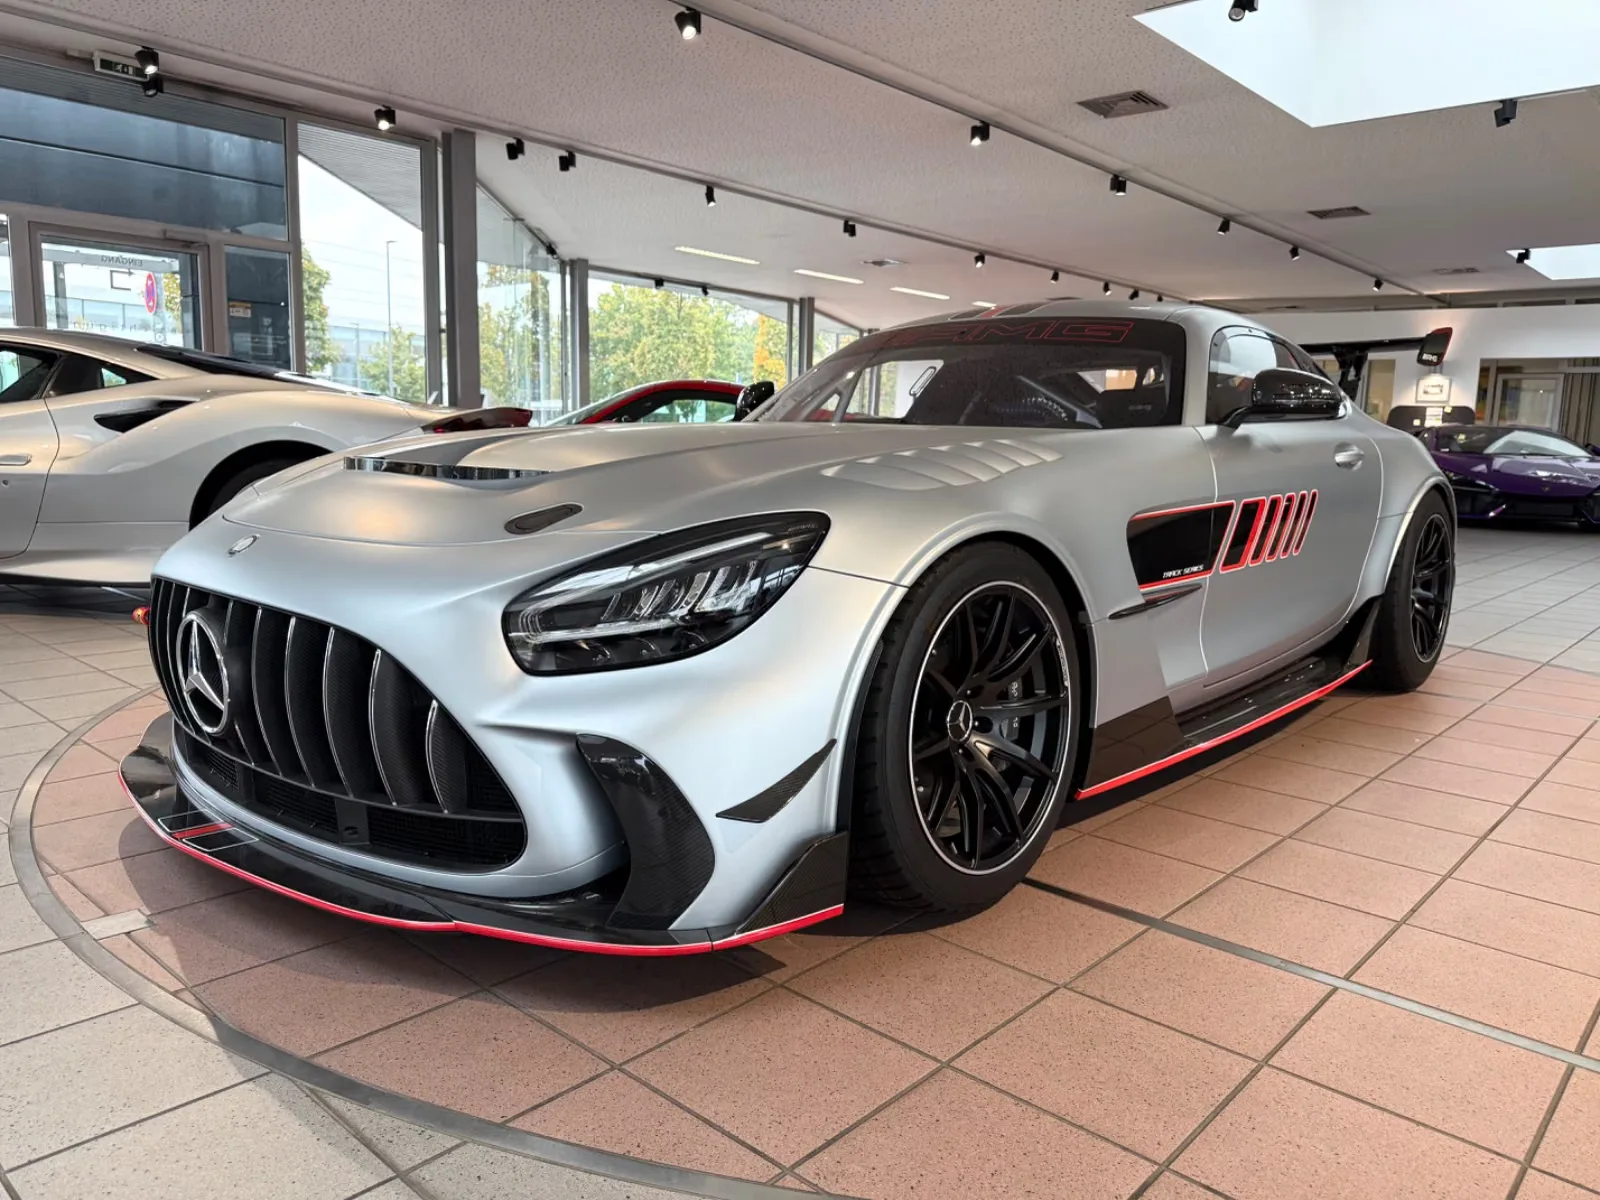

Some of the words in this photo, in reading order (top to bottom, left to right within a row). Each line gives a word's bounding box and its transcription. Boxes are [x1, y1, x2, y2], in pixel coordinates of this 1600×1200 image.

[896, 319, 1134, 345] AMG
[1163, 569, 1182, 579] TRACK
[1183, 564, 1204, 575] SERIES
